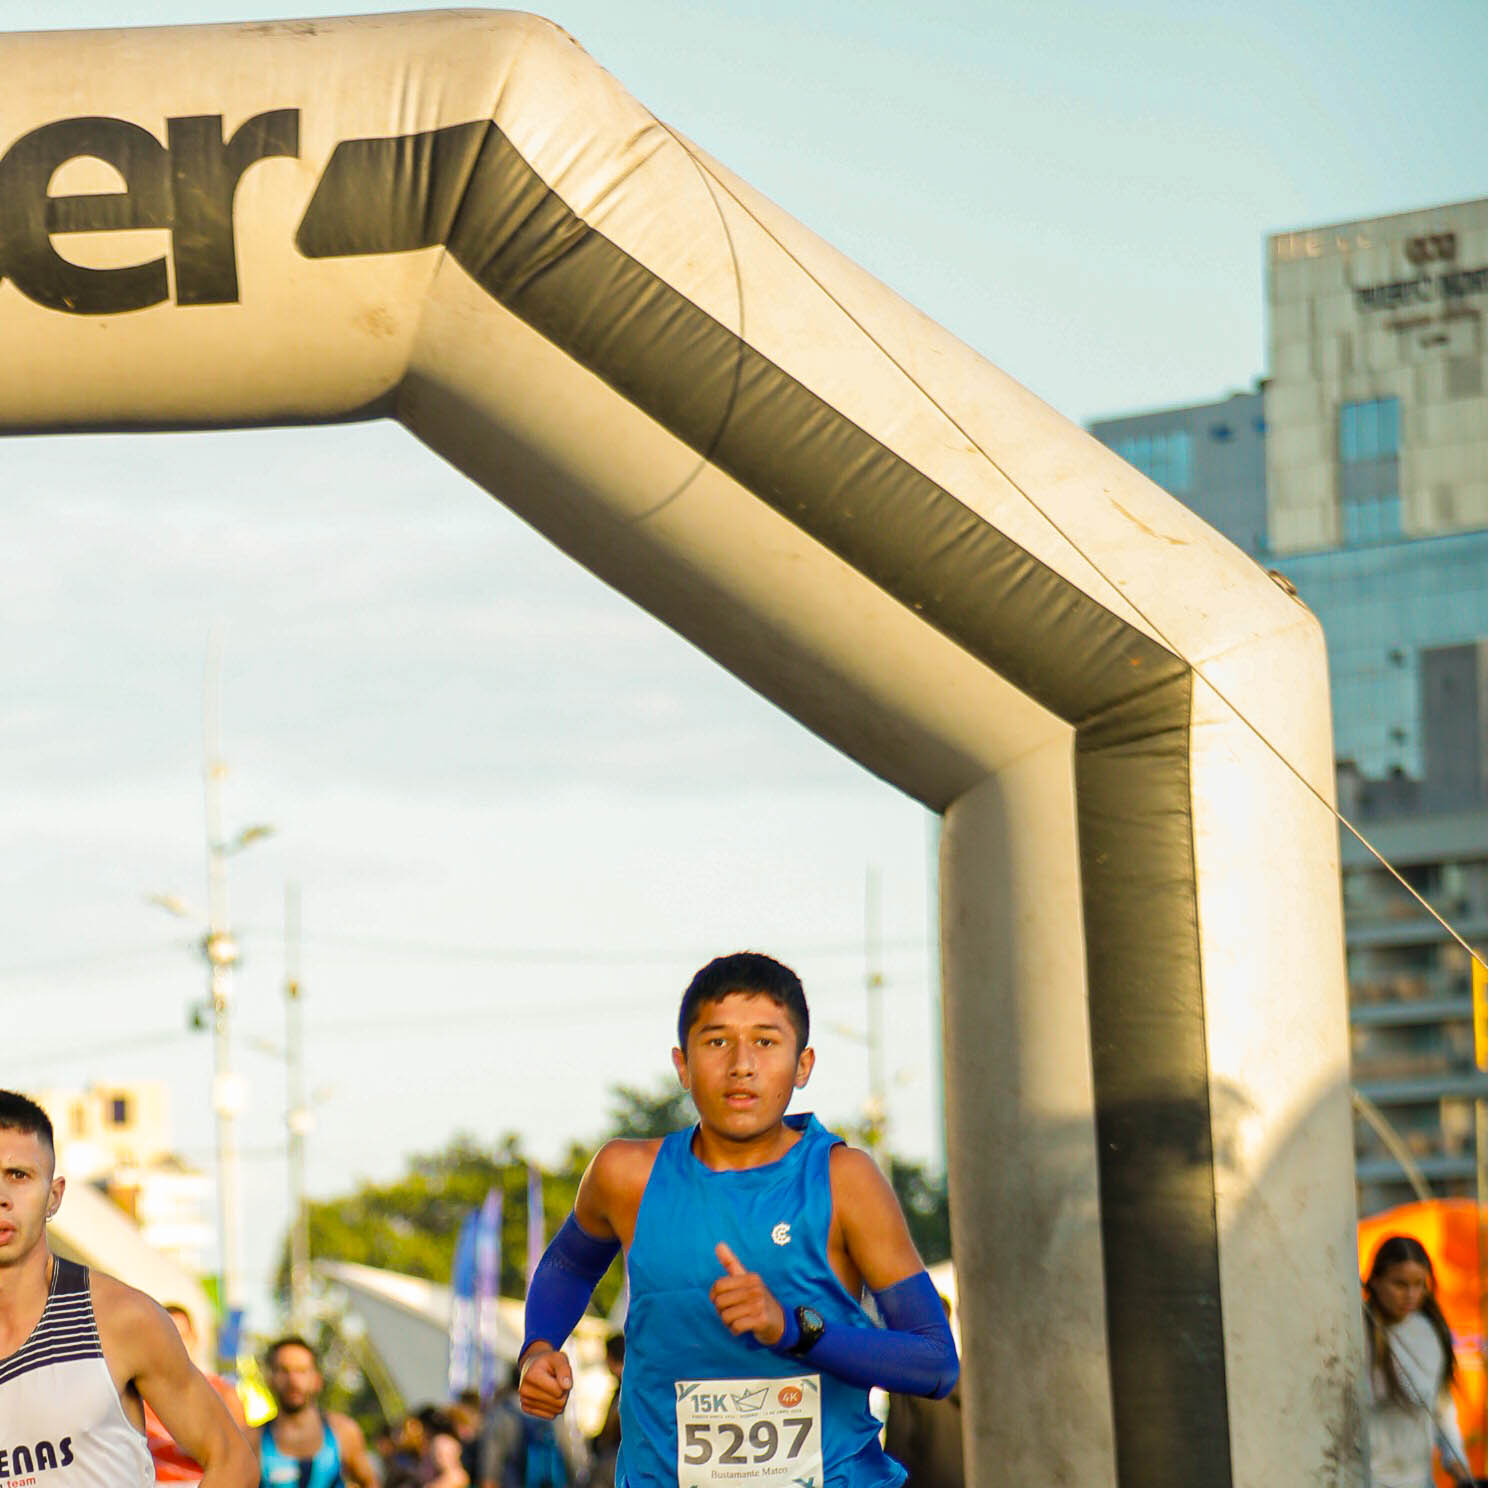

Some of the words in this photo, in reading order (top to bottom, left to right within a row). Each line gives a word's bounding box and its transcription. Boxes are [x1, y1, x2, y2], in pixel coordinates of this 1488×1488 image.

[692, 1394, 728, 1413] 15K
[782, 1392, 798, 1402] 4K
[684, 1417, 813, 1465] 5297
[7, 1476, 36, 1488] team
[712, 1469, 759, 1480] Bustamante
